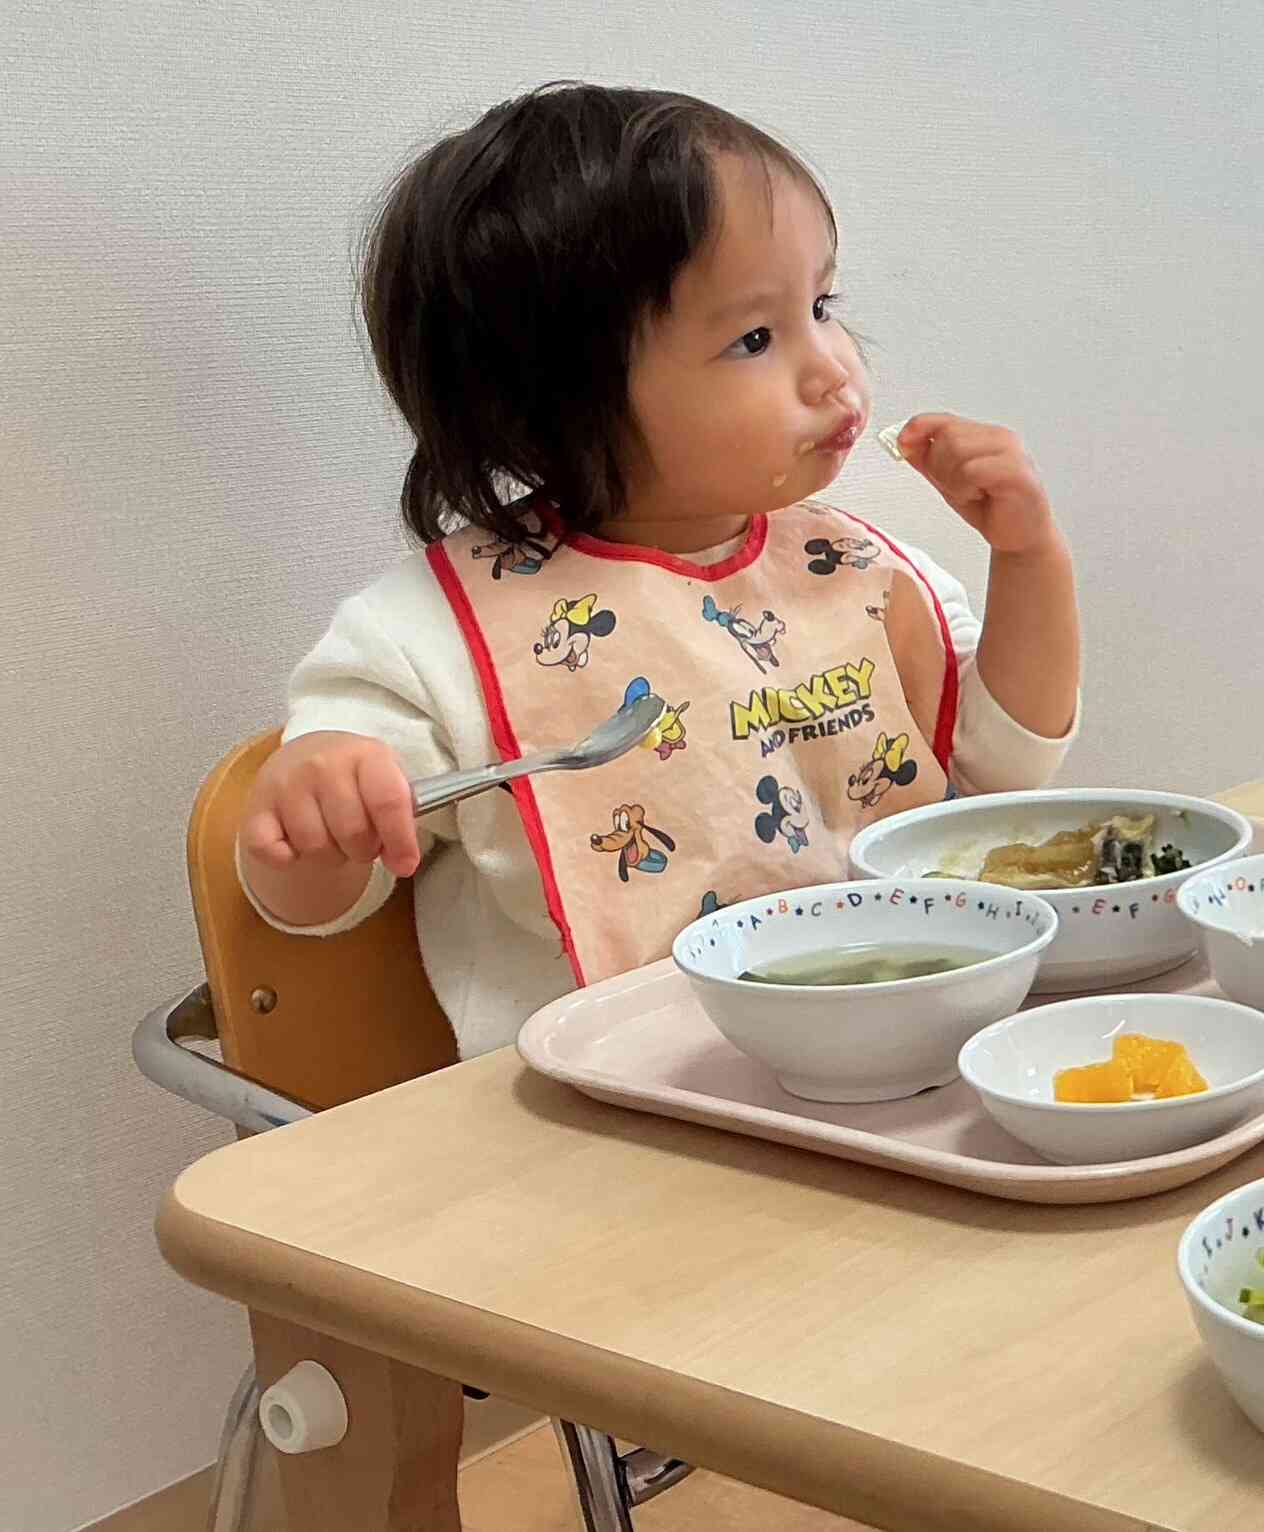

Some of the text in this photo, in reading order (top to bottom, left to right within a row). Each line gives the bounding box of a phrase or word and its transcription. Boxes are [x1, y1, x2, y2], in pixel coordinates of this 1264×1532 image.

[730, 656, 876, 740] MICKEY
[760, 702, 876, 758] AND FRIENDS
[750, 914, 763, 931] A
[777, 898, 789, 914] B
[810, 902, 823, 917] C
[847, 892, 863, 908] D
[889, 887, 905, 905] E
[923, 897, 935, 915] F
[955, 891, 967, 908] G
[985, 903, 999, 920] H
[1092, 898, 1107, 916] E
[1128, 903, 1140, 919] F
